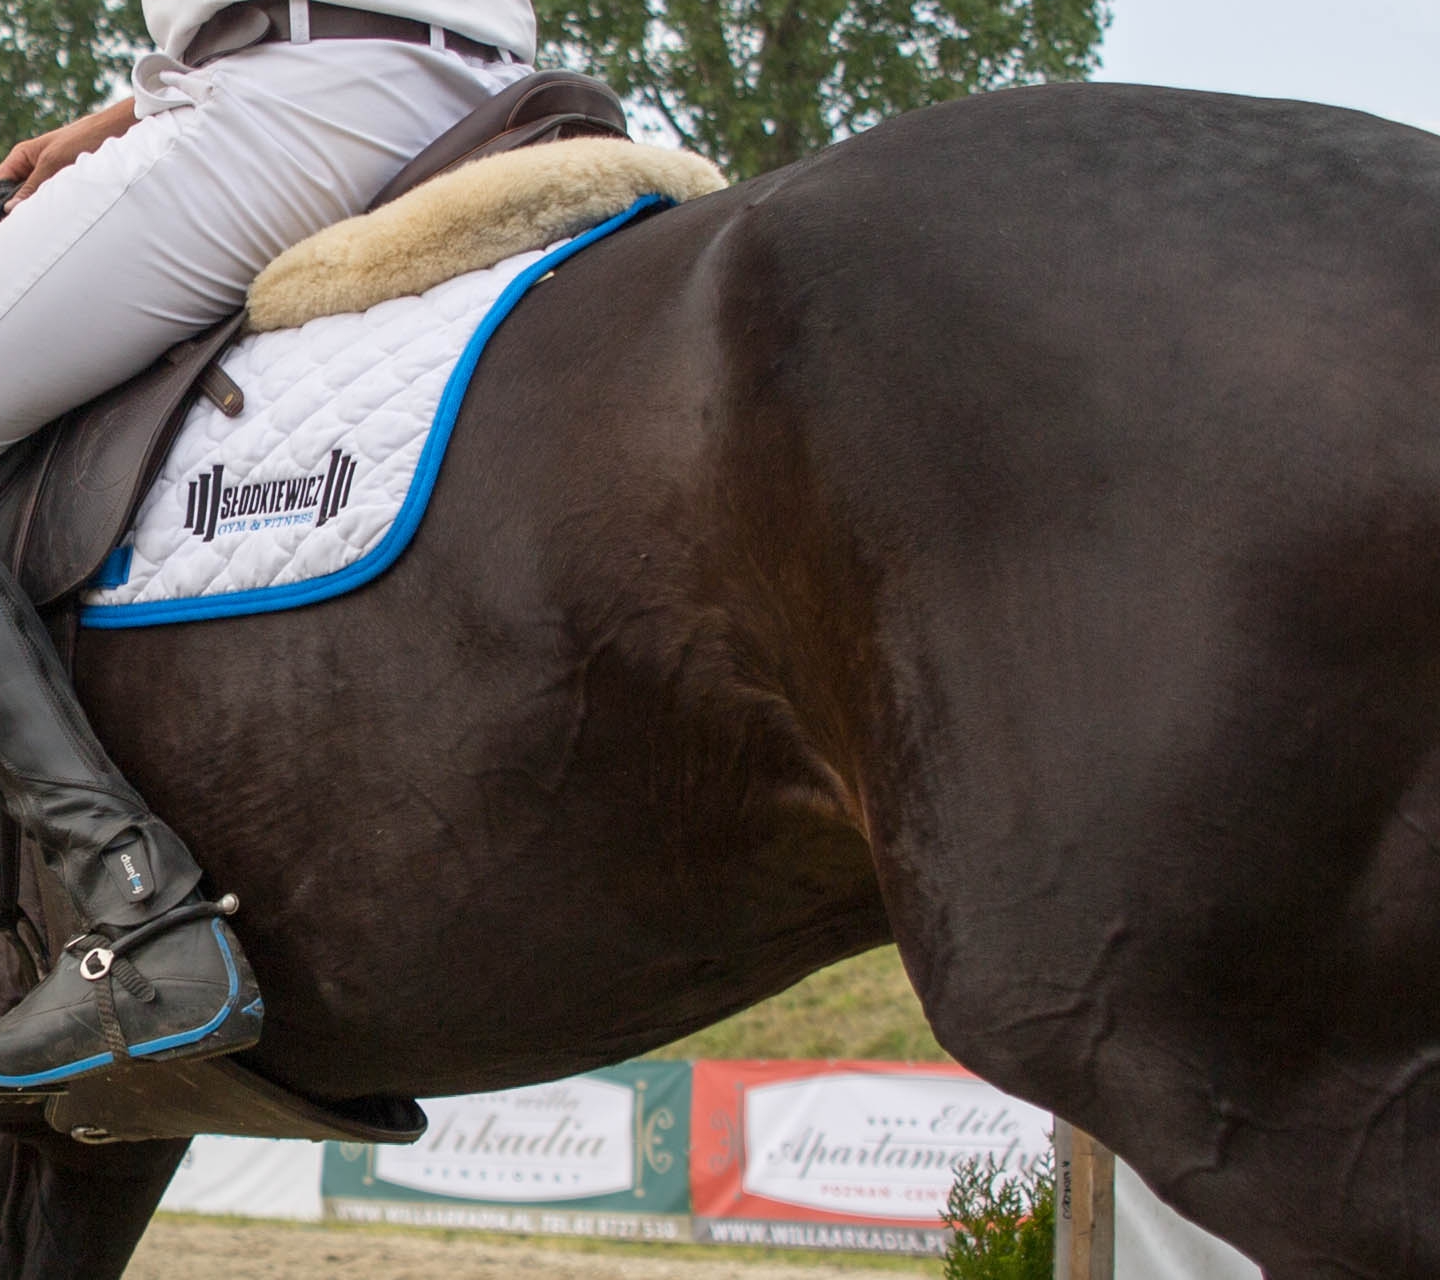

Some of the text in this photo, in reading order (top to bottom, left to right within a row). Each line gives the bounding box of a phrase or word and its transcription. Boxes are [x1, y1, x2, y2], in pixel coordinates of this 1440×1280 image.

[220, 474, 325, 521] SŁODKIEWICZ
[217, 521, 246, 536] GYM
[264, 511, 314, 529] FITNESS
